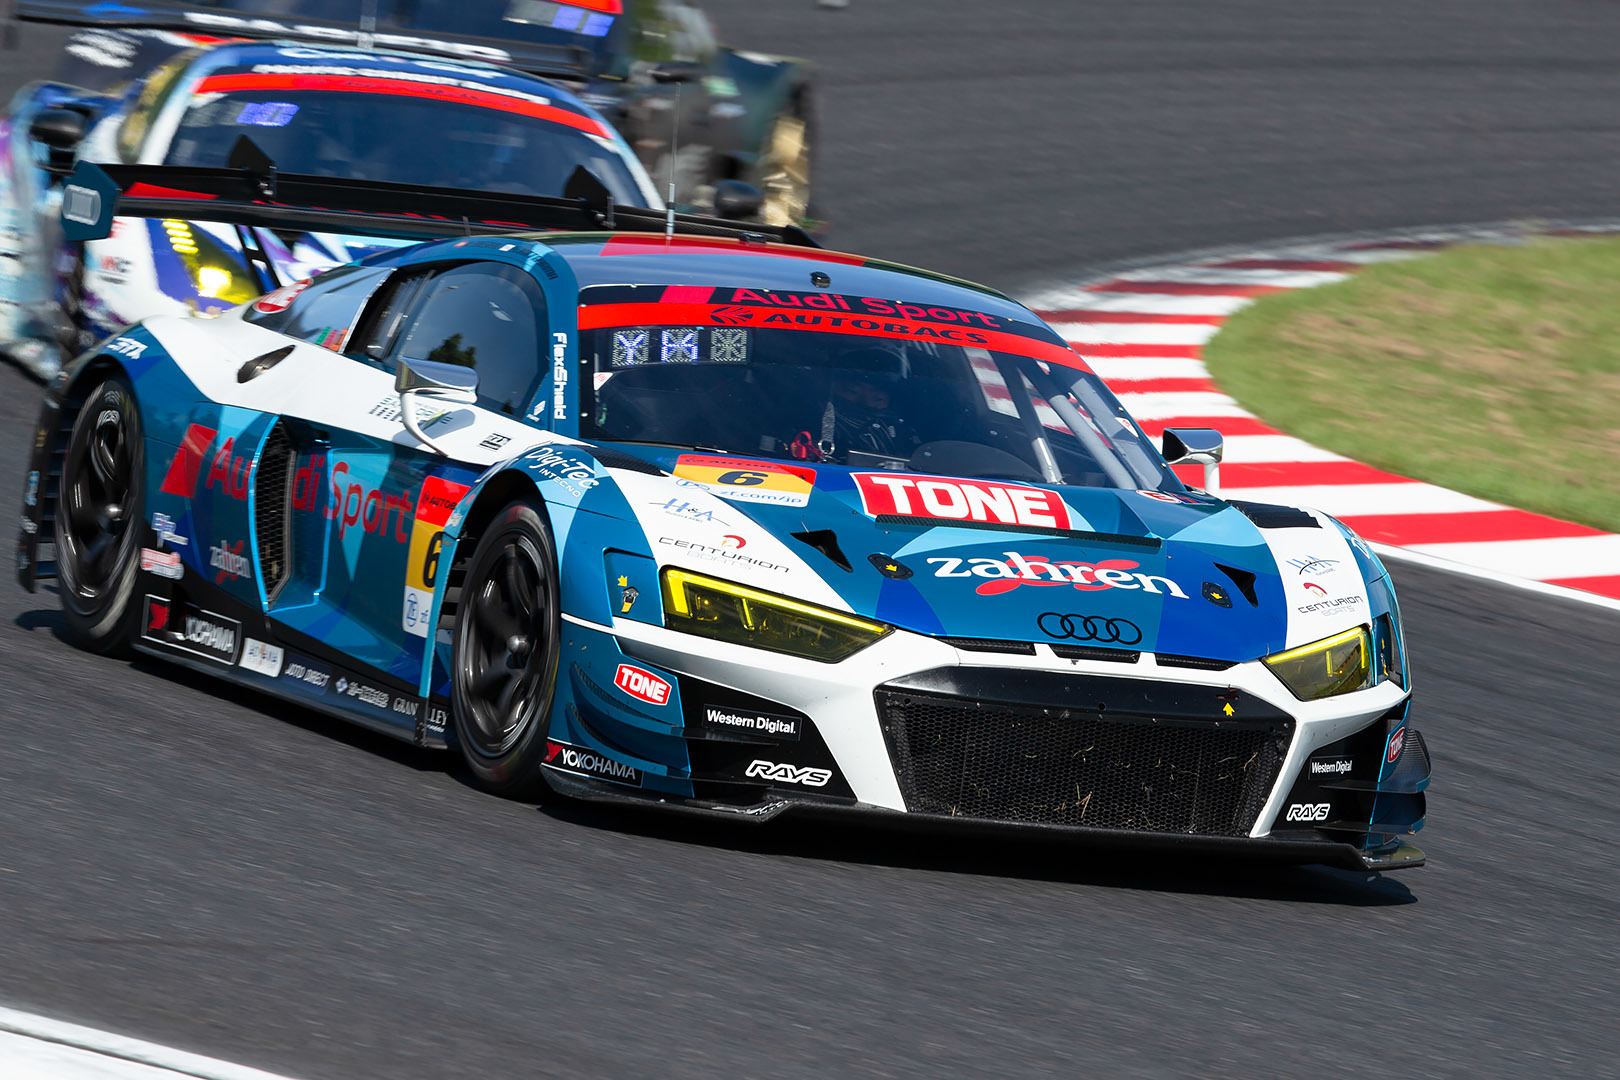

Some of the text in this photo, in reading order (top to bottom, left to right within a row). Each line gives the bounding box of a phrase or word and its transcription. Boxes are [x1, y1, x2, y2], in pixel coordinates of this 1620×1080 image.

[731, 287, 1001, 328] Audi Sport
[762, 313, 990, 344] AUTOBACS
[552, 332, 568, 420] FlexShield
[525, 447, 600, 490] Digi-Tec
[538, 468, 582, 498] INTECNO
[717, 470, 769, 486] 6
[205, 436, 414, 544] Audi Sport
[429, 496, 457, 511] AUTOB
[870, 475, 1057, 529] TONE
[663, 498, 714, 521] H&A
[422, 530, 443, 588] 6
[658, 536, 790, 573] CENTURION
[926, 551, 1190, 599] zahren
[1297, 595, 1364, 614] CENTURION
[620, 665, 667, 704] TONE
[706, 709, 754, 728] Western
[562, 748, 636, 780] YOKOHAMA
[745, 759, 833, 787] RAYS
[1311, 761, 1336, 774] Western
[1286, 803, 1331, 821] RAYS
